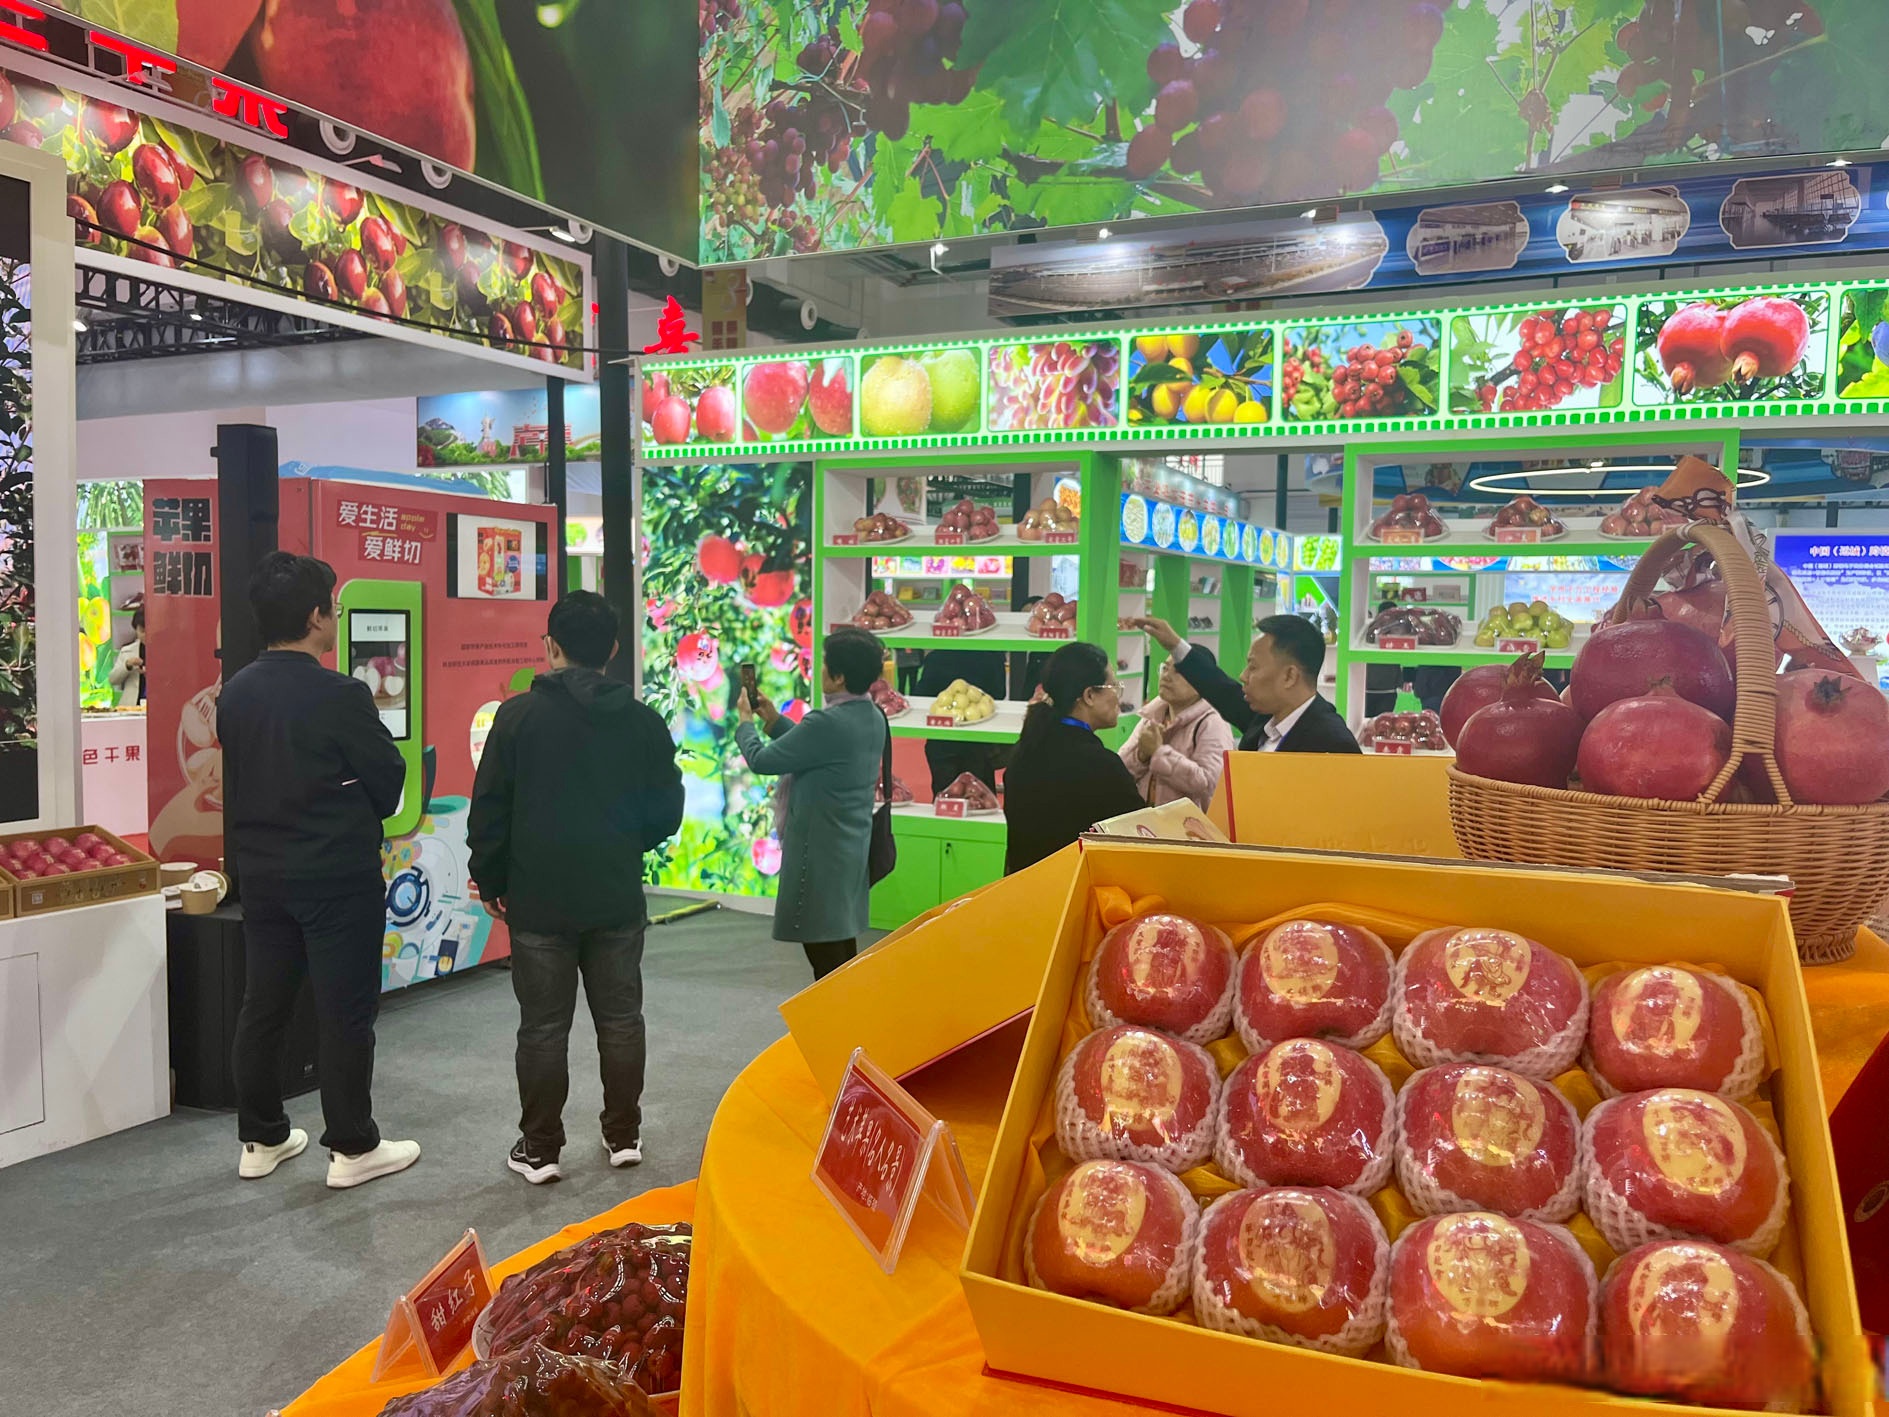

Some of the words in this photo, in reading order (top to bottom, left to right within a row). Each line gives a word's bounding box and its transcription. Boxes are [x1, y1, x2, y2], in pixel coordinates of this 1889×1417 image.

[152, 497, 213, 543] 苹果
[338, 500, 399, 531] 爱生活
[400, 513, 425, 523] apple
[363, 535, 421, 564] 爱鲜切
[152, 551, 214, 598] 鲜切
[430, 1268, 476, 1332] 甜红子
